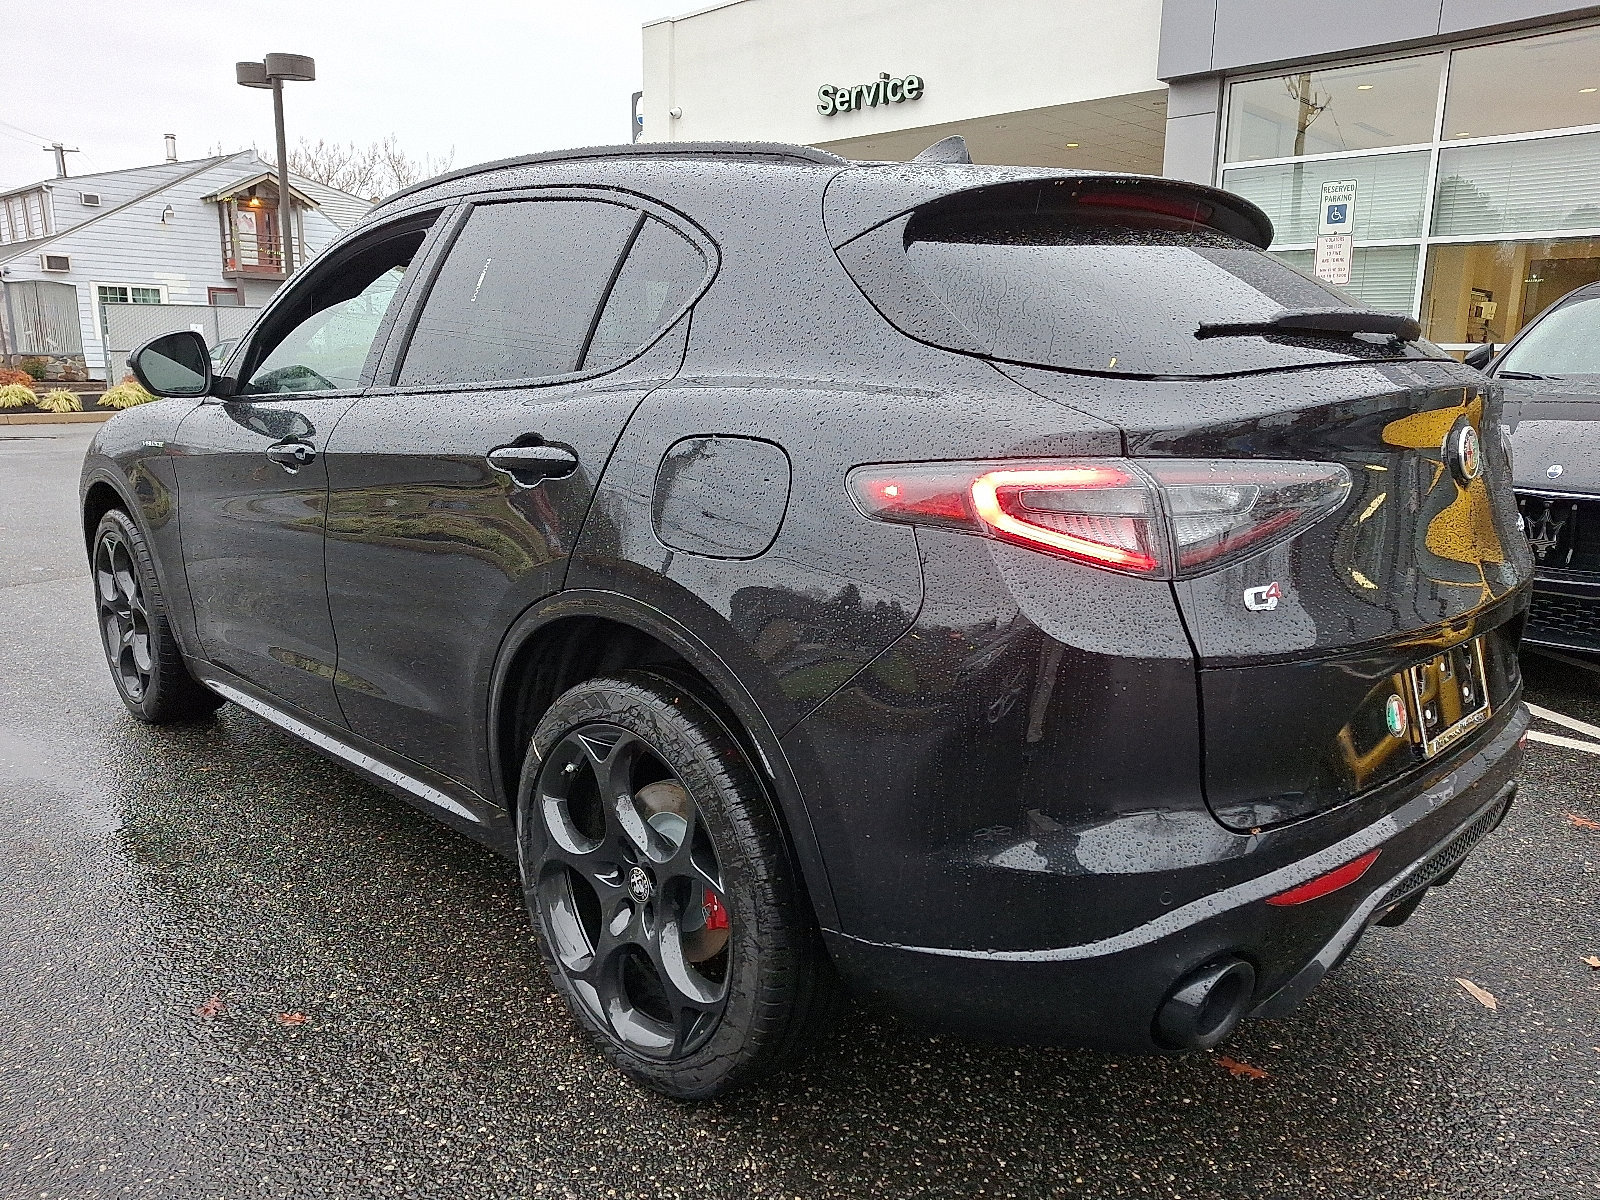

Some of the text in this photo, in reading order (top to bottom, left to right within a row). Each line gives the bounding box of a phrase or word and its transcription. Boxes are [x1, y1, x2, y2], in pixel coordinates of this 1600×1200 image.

[817, 72, 924, 116] Service
[1323, 184, 1355, 193] RESERVED
[1324, 194, 1352, 203] PARKING
